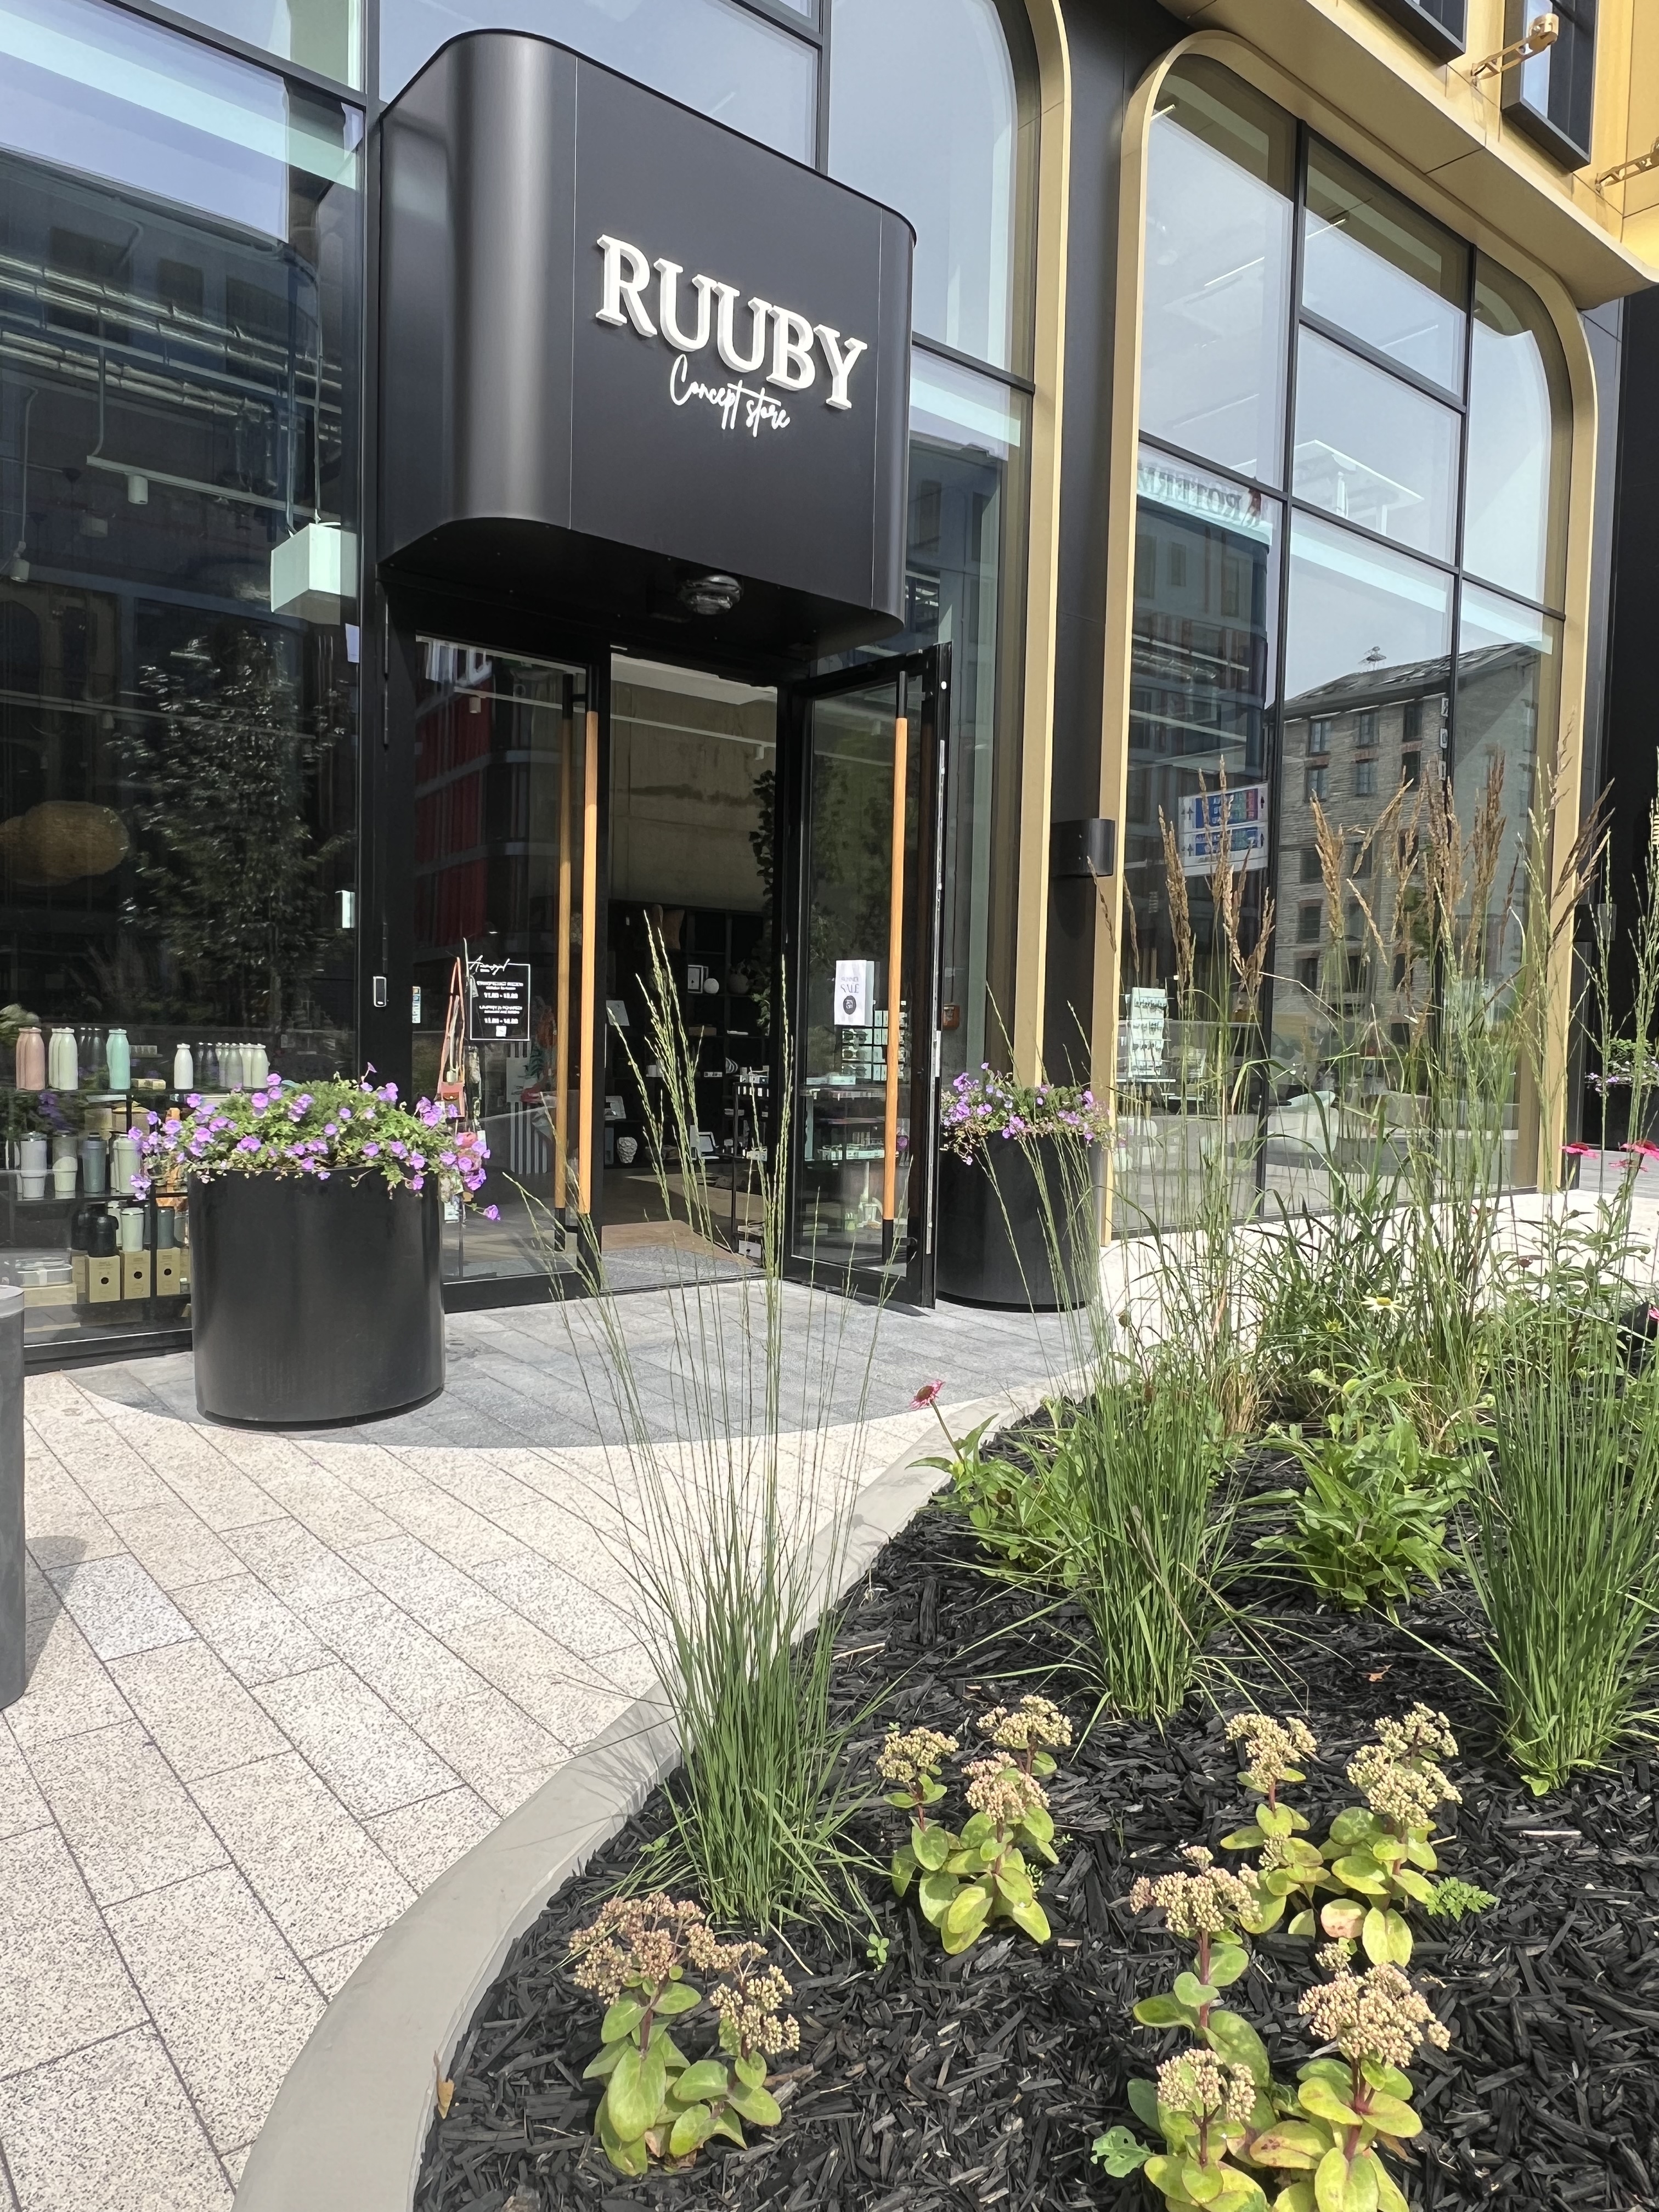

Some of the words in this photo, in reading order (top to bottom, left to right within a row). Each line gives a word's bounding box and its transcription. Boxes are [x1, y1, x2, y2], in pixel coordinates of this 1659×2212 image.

[596, 234, 868, 410] RUUBY
[670, 354, 743, 430] Concept
[746, 387, 791, 438] store
